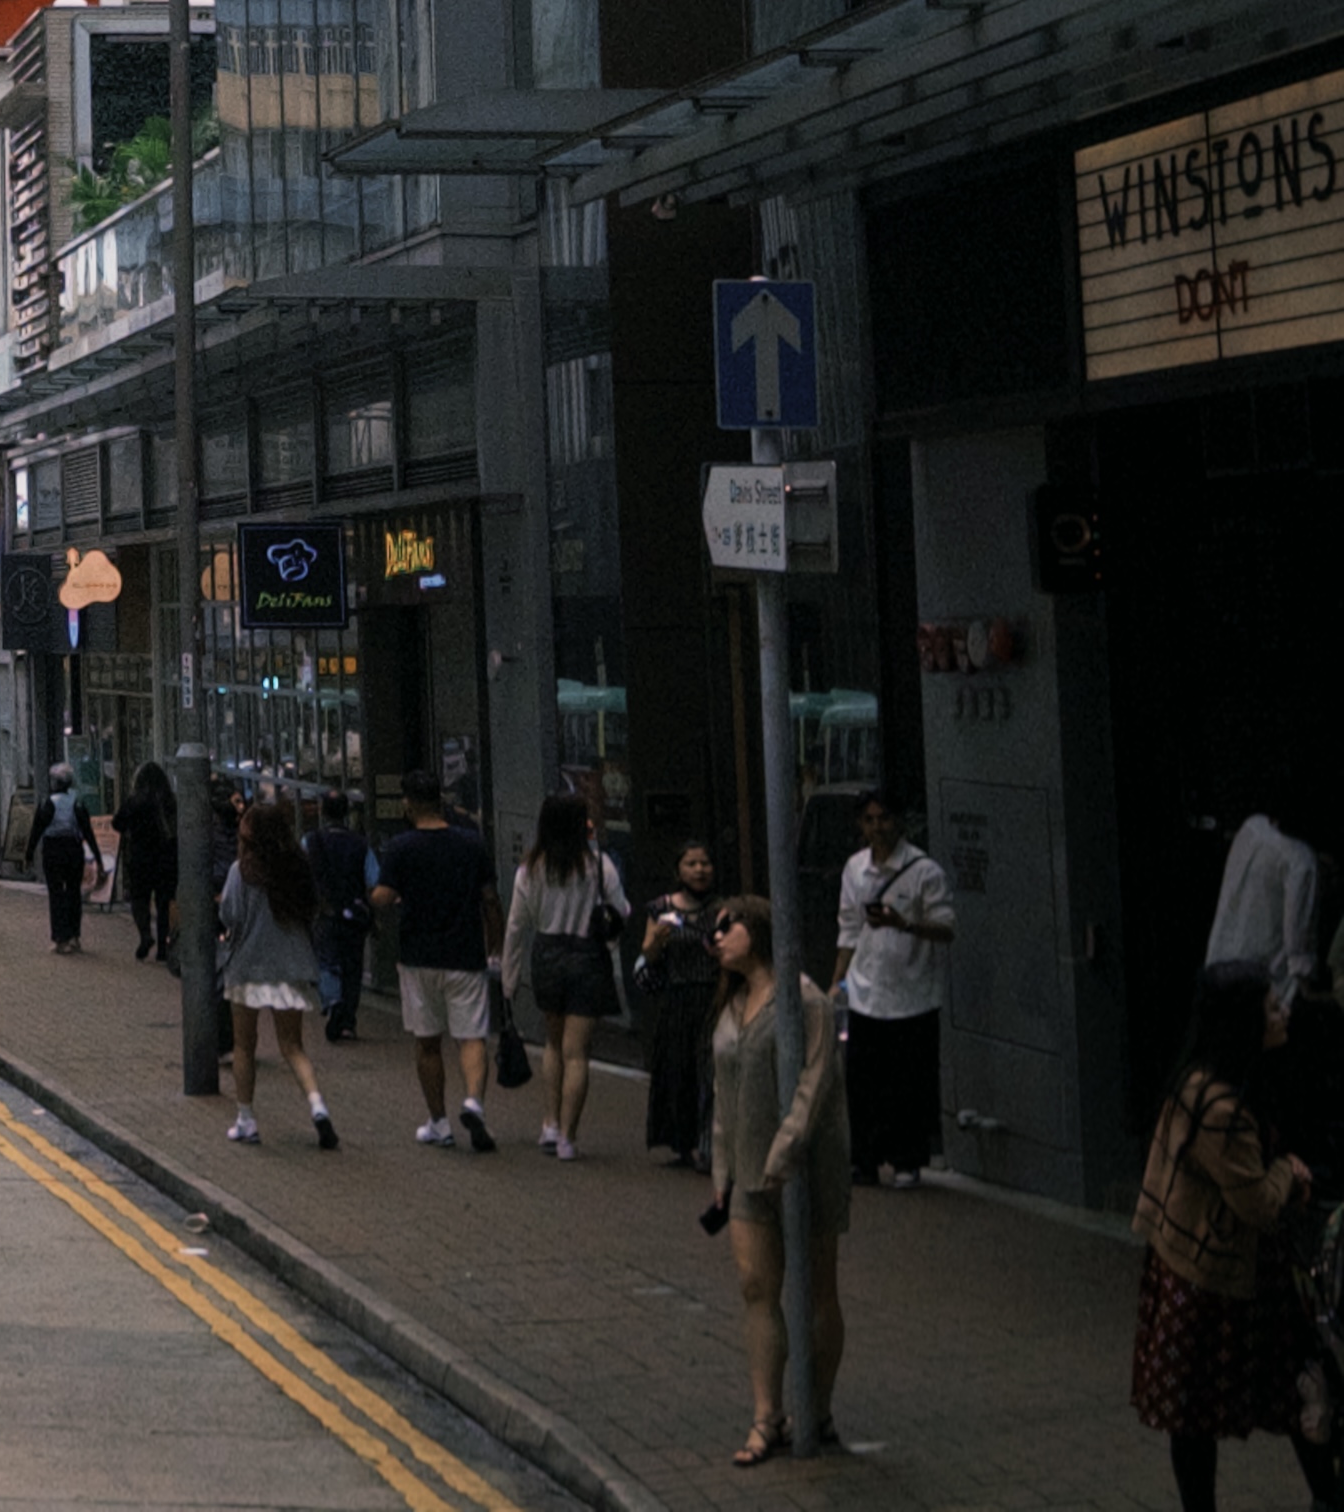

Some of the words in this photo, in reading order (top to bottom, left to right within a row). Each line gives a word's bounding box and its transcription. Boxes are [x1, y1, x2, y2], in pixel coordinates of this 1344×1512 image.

[1098, 112, 1336, 254] WINSTONS
[729, 479, 753, 504] Davis
[755, 479, 782, 505] Street
